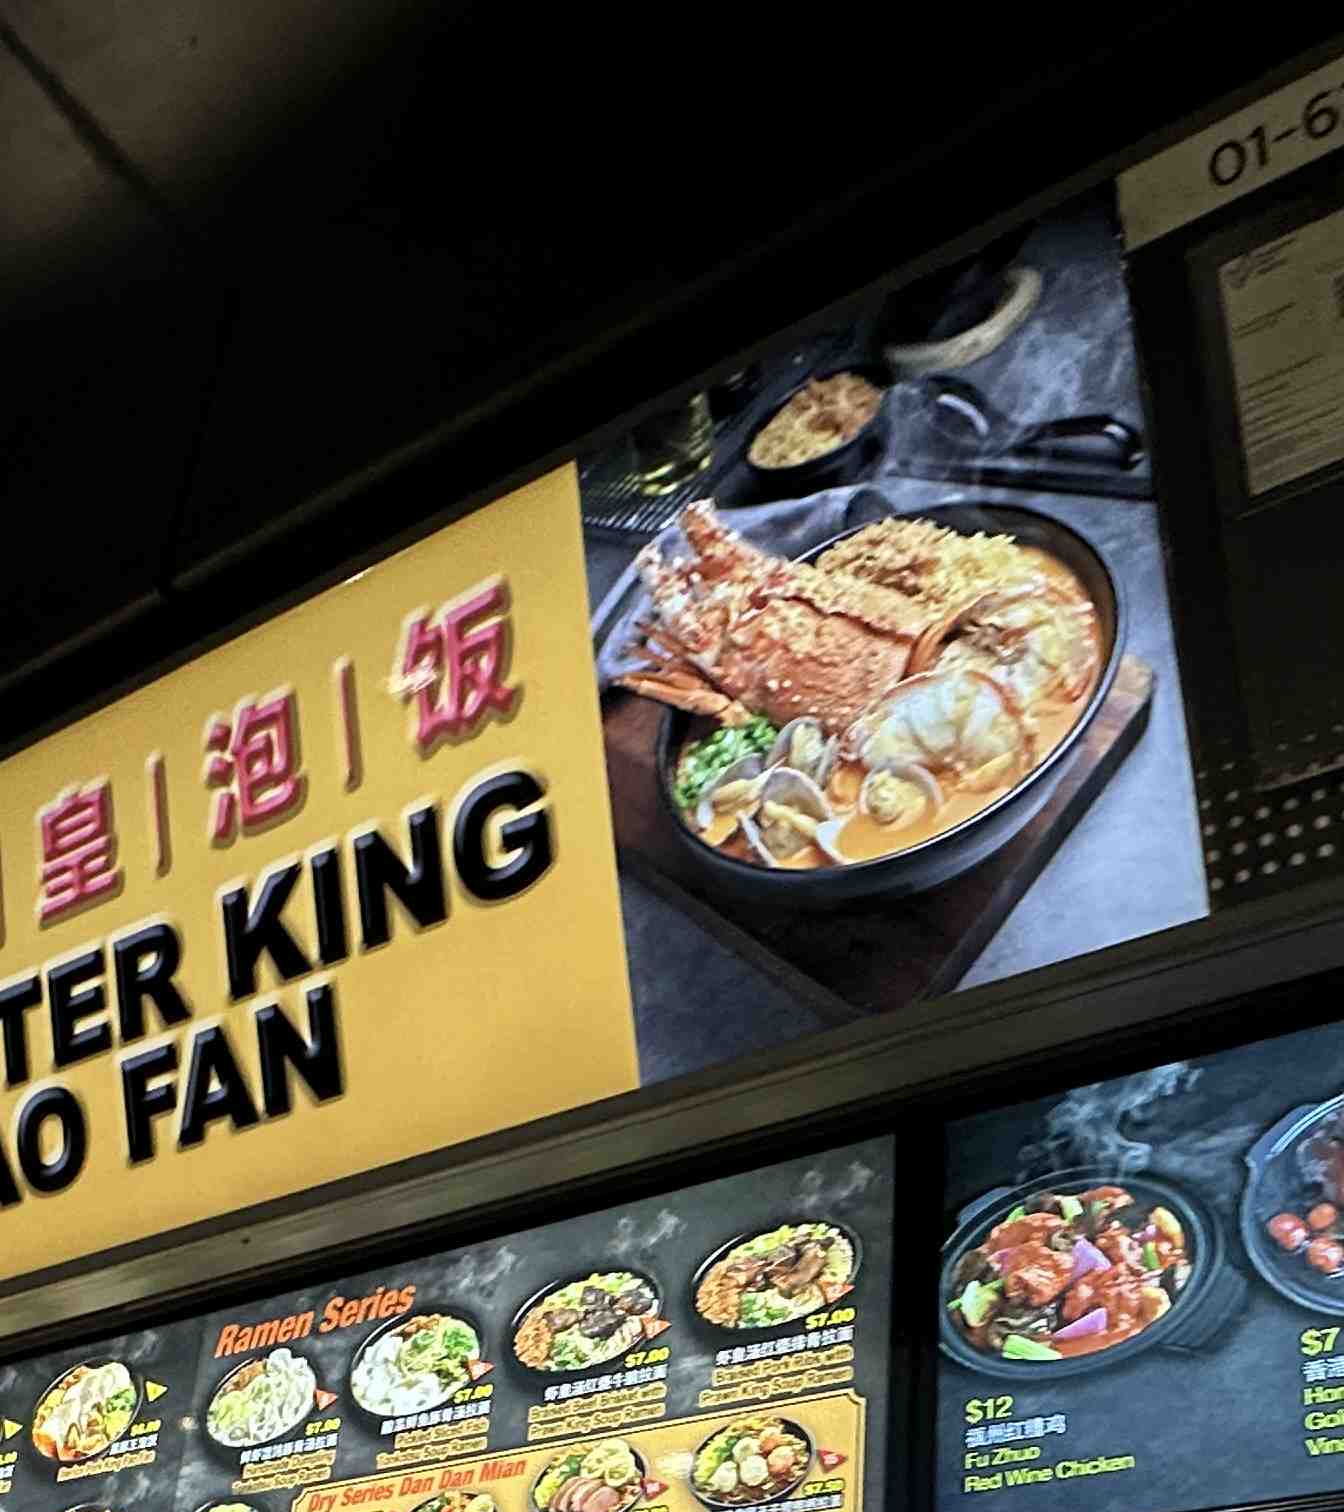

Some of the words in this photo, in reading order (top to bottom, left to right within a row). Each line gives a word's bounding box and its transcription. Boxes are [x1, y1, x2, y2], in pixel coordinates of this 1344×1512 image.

[220, 765, 551, 1001] KING
[120, 980, 342, 1164] FAN
[214, 1311, 315, 1359] Ramen
[319, 1284, 417, 1335] Series
[1300, 1327, 1341, 1356] $7
[965, 1395, 1014, 1424] $12
[964, 1473, 1003, 1493] Red
[1005, 1468, 1054, 1487] Wine
[1055, 1456, 1136, 1480] Chicken
[965, 1452, 988, 1469] Fu
[340, 1481, 394, 1509] Series
[397, 1476, 432, 1499] Dan
[438, 1469, 473, 1491] Dan
[478, 1459, 526, 1484] Mian
